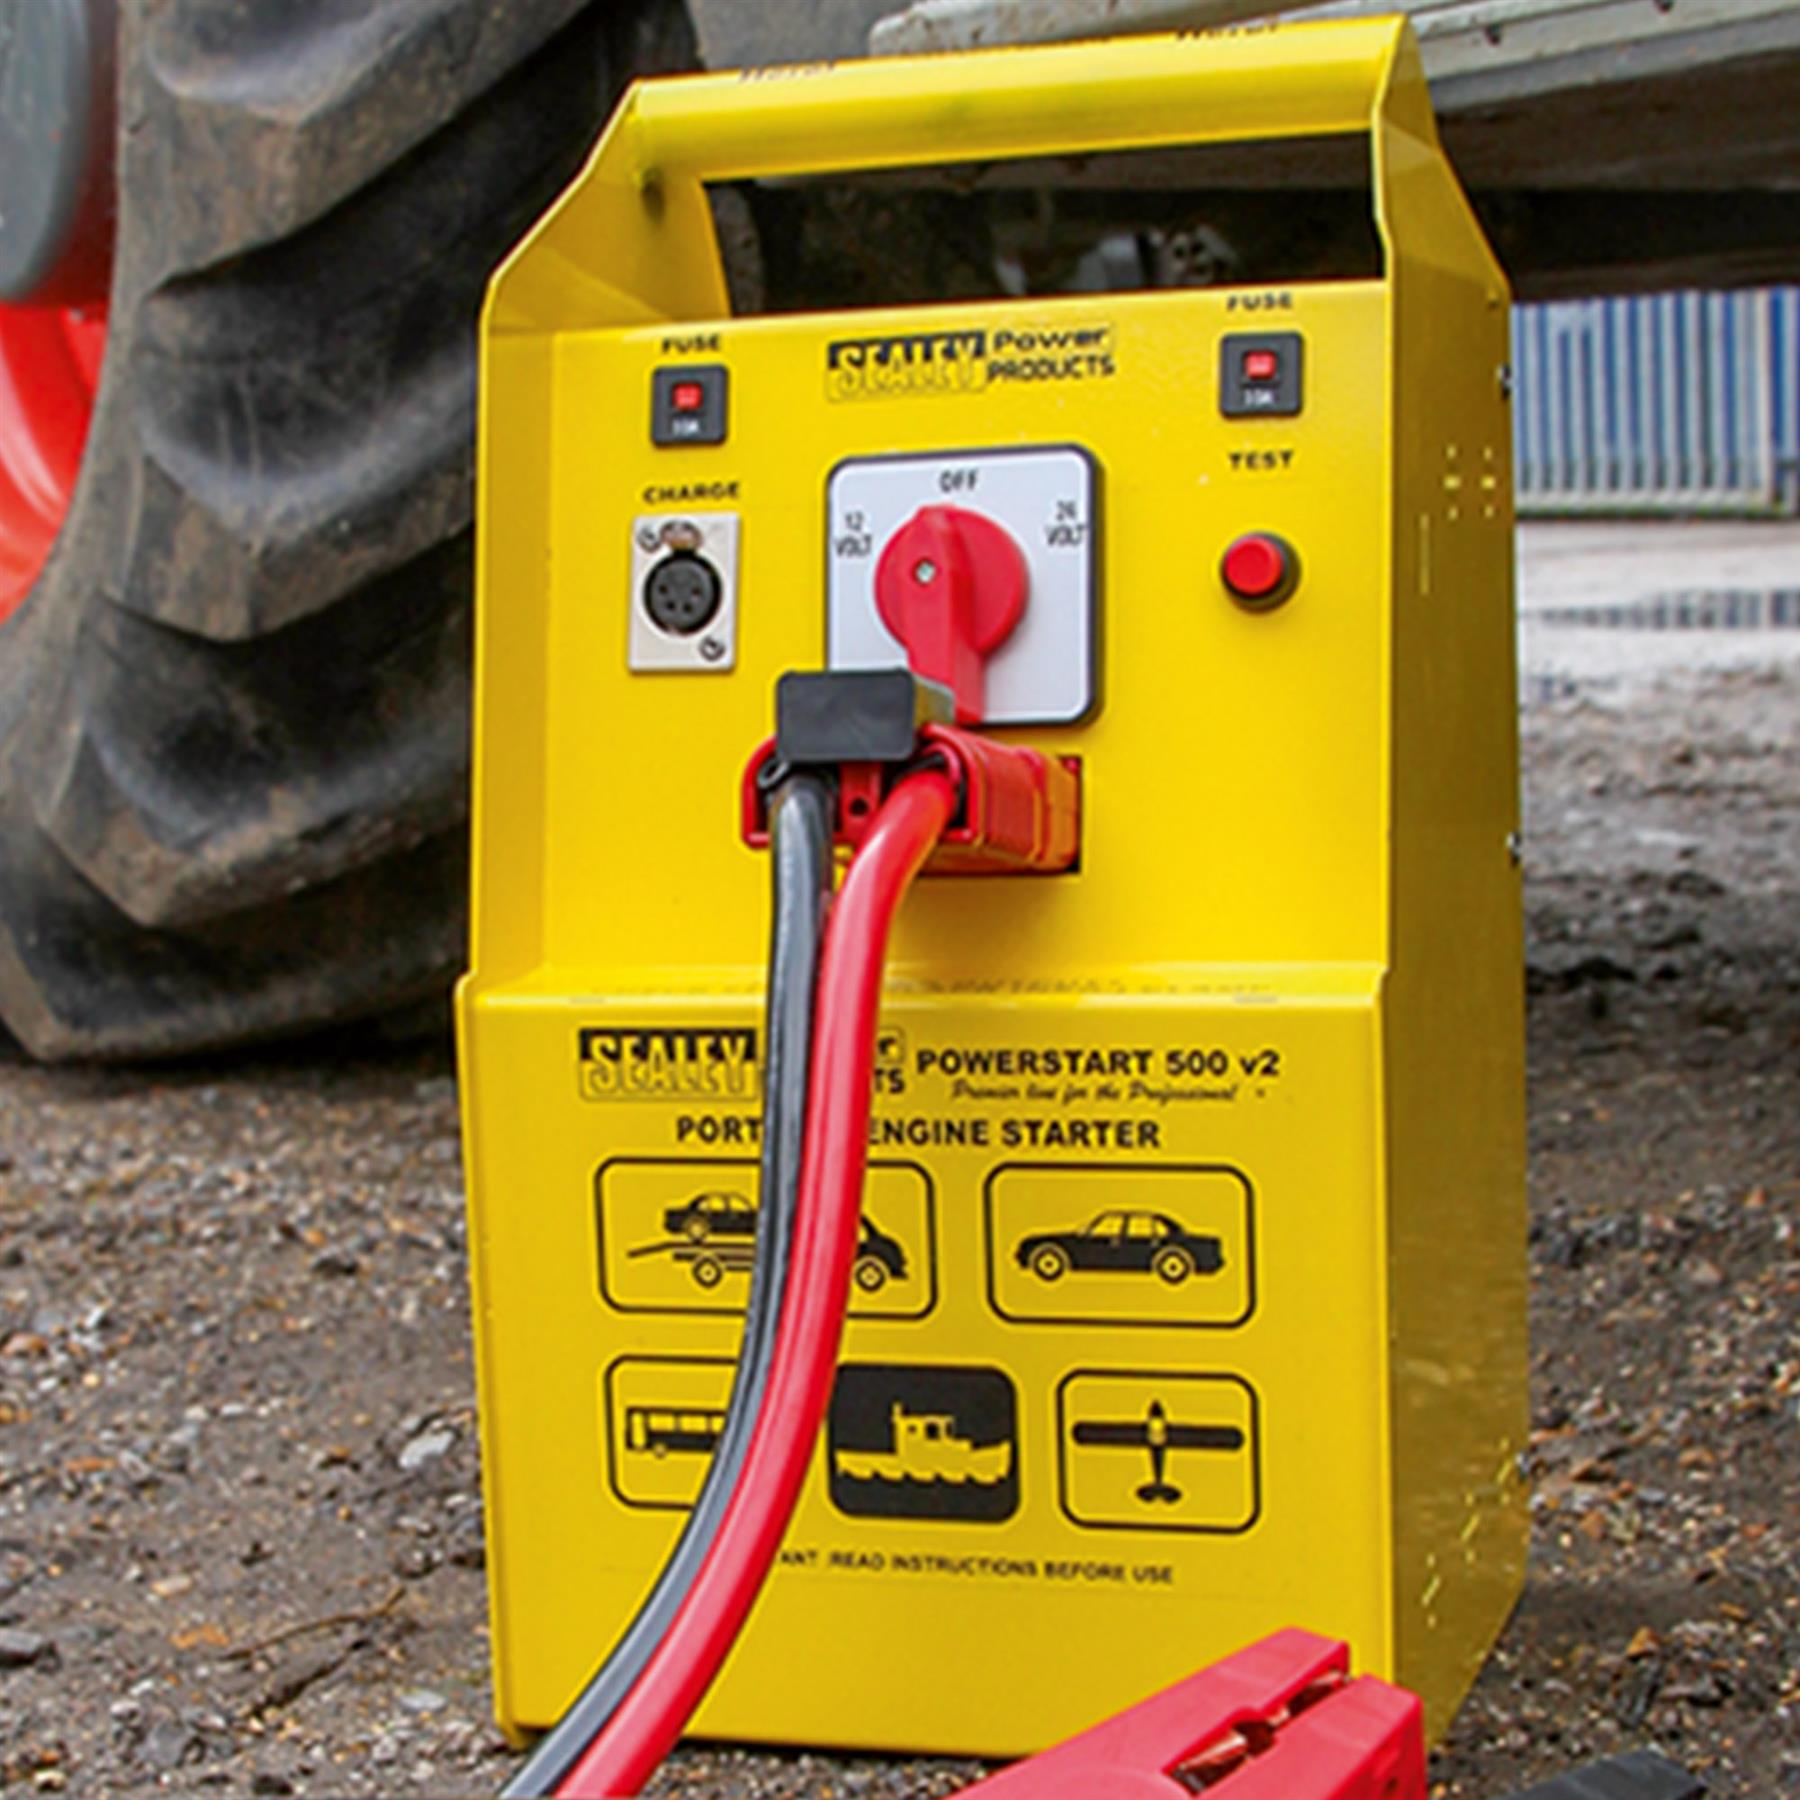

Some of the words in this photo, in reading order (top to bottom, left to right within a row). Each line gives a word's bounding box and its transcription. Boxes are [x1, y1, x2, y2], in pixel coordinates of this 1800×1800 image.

[1227, 293, 1293, 312] FUSE
[662, 335, 721, 352] FUSE
[994, 328, 1110, 352] Power
[988, 356, 1115, 382] PRODUCTS
[1228, 451, 1294, 470] TEST
[643, 481, 741, 504] CHARGE
[939, 470, 979, 492] OFF
[836, 534, 873, 557] VOLT
[1044, 523, 1085, 547] VOLT
[580, 1028, 757, 1100] SEALEY
[917, 1048, 1152, 1076] POWERSTART
[1166, 1049, 1228, 1076] 500
[1240, 1050, 1281, 1077] v2
[676, 1116, 763, 1143] PORT
[870, 1117, 989, 1146] ENGINE
[1002, 1118, 1160, 1149] STARTER
[892, 1554, 1037, 1578] INSTRUCTIONS
[1045, 1561, 1126, 1582] BEFORE
[1133, 1565, 1174, 1584] USE
